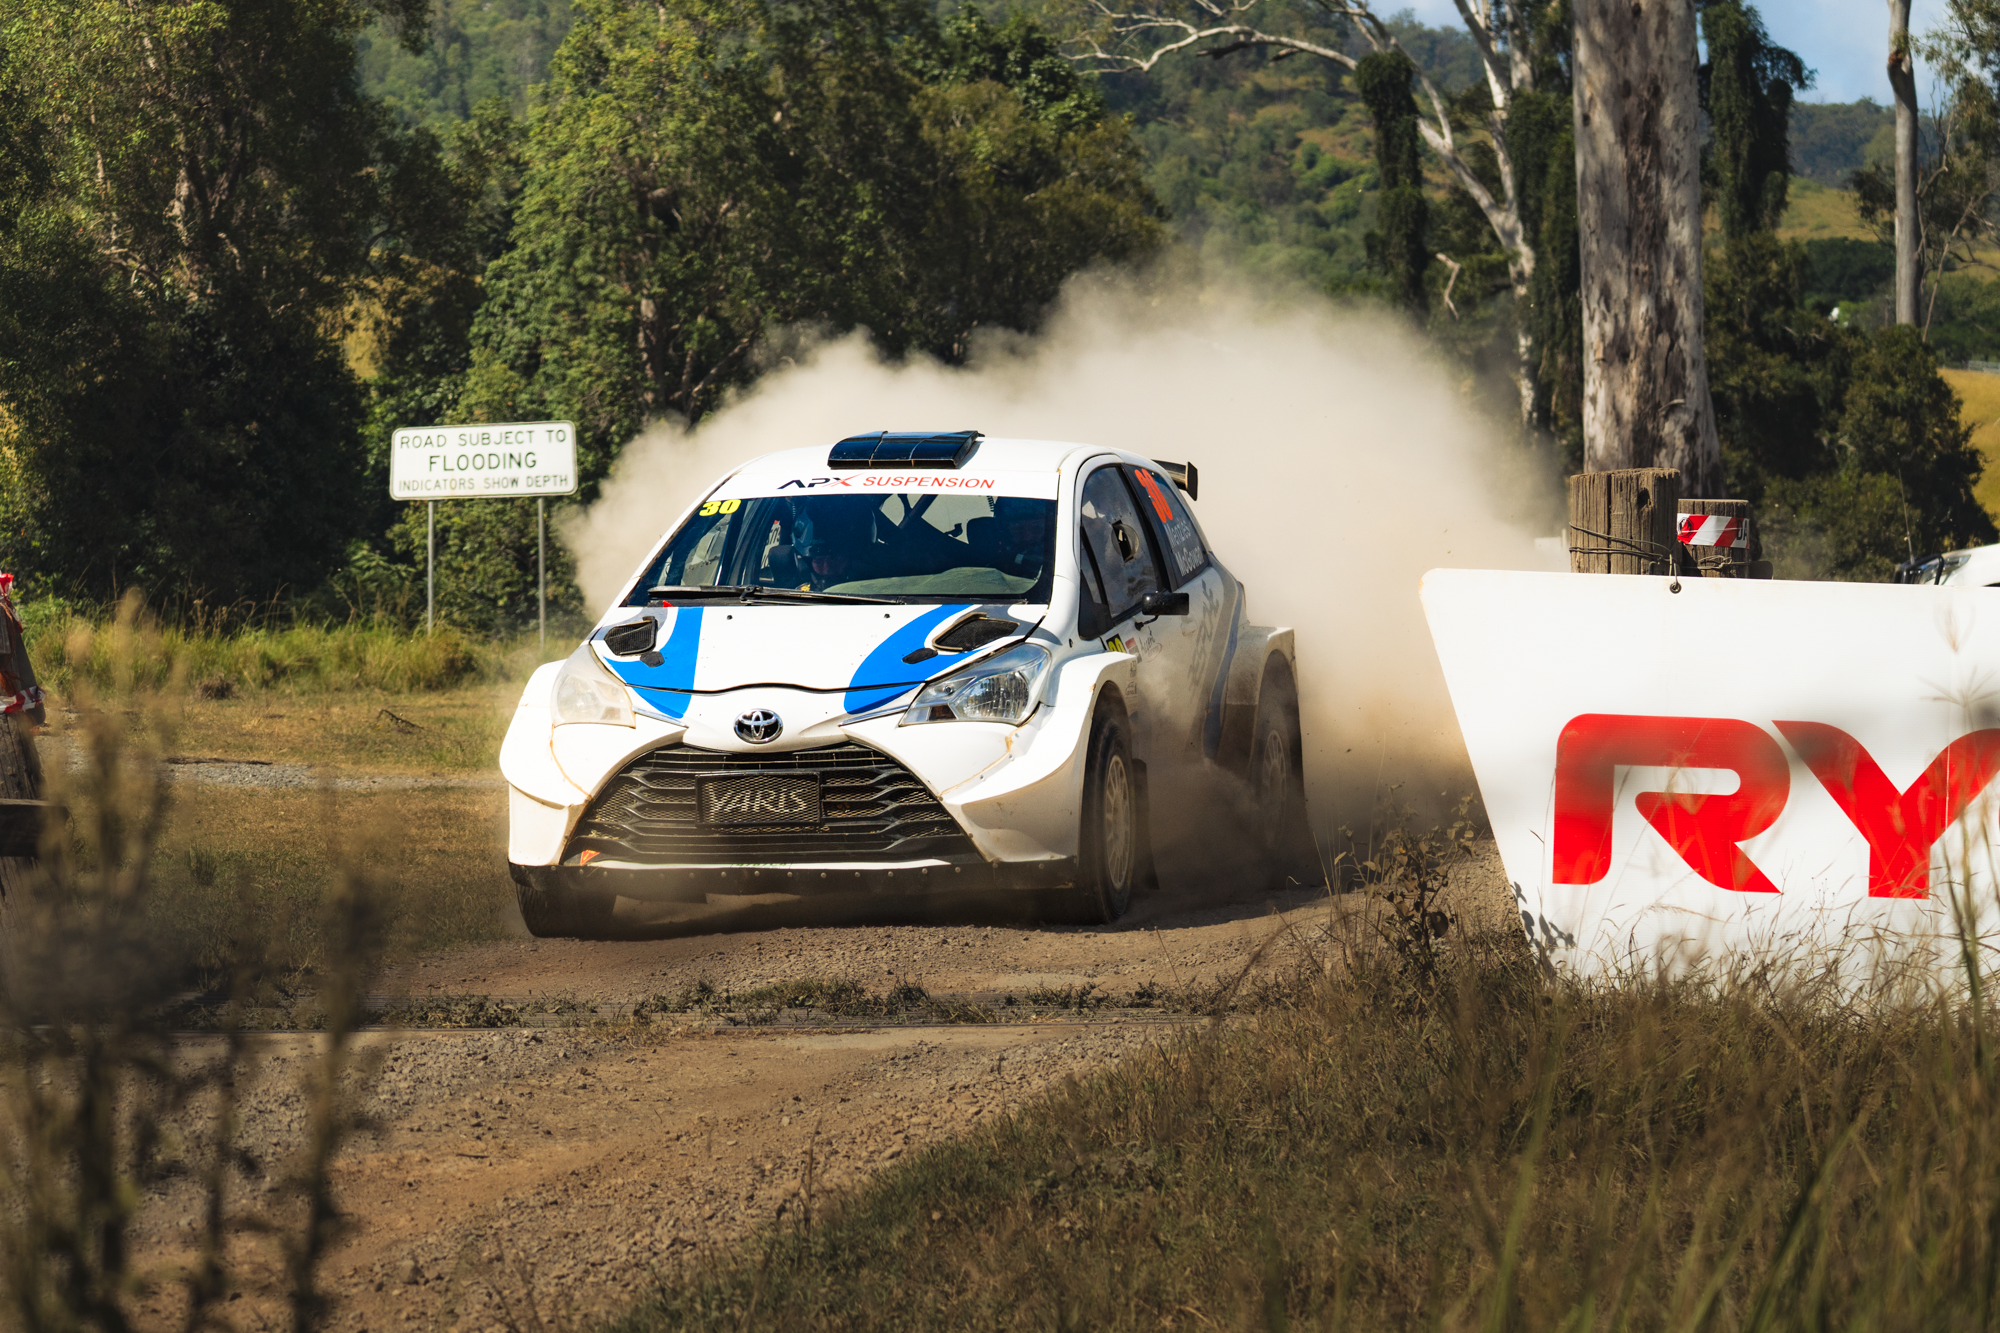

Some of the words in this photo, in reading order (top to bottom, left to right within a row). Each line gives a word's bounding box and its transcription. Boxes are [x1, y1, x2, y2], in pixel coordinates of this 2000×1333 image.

[400, 434, 447, 449] ROAD
[458, 430, 535, 447] SUBJECT
[545, 429, 567, 443] TO
[429, 452, 537, 472] FLOODING
[399, 478, 475, 492] INDICATORS
[483, 477, 520, 490] SHOW
[526, 474, 568, 489] DEPTH
[776, 475, 859, 489] APX
[863, 476, 995, 489] SUSPENSION
[1134, 468, 1173, 523] 30
[699, 499, 741, 516] 30
[709, 785, 808, 817] YARIS
